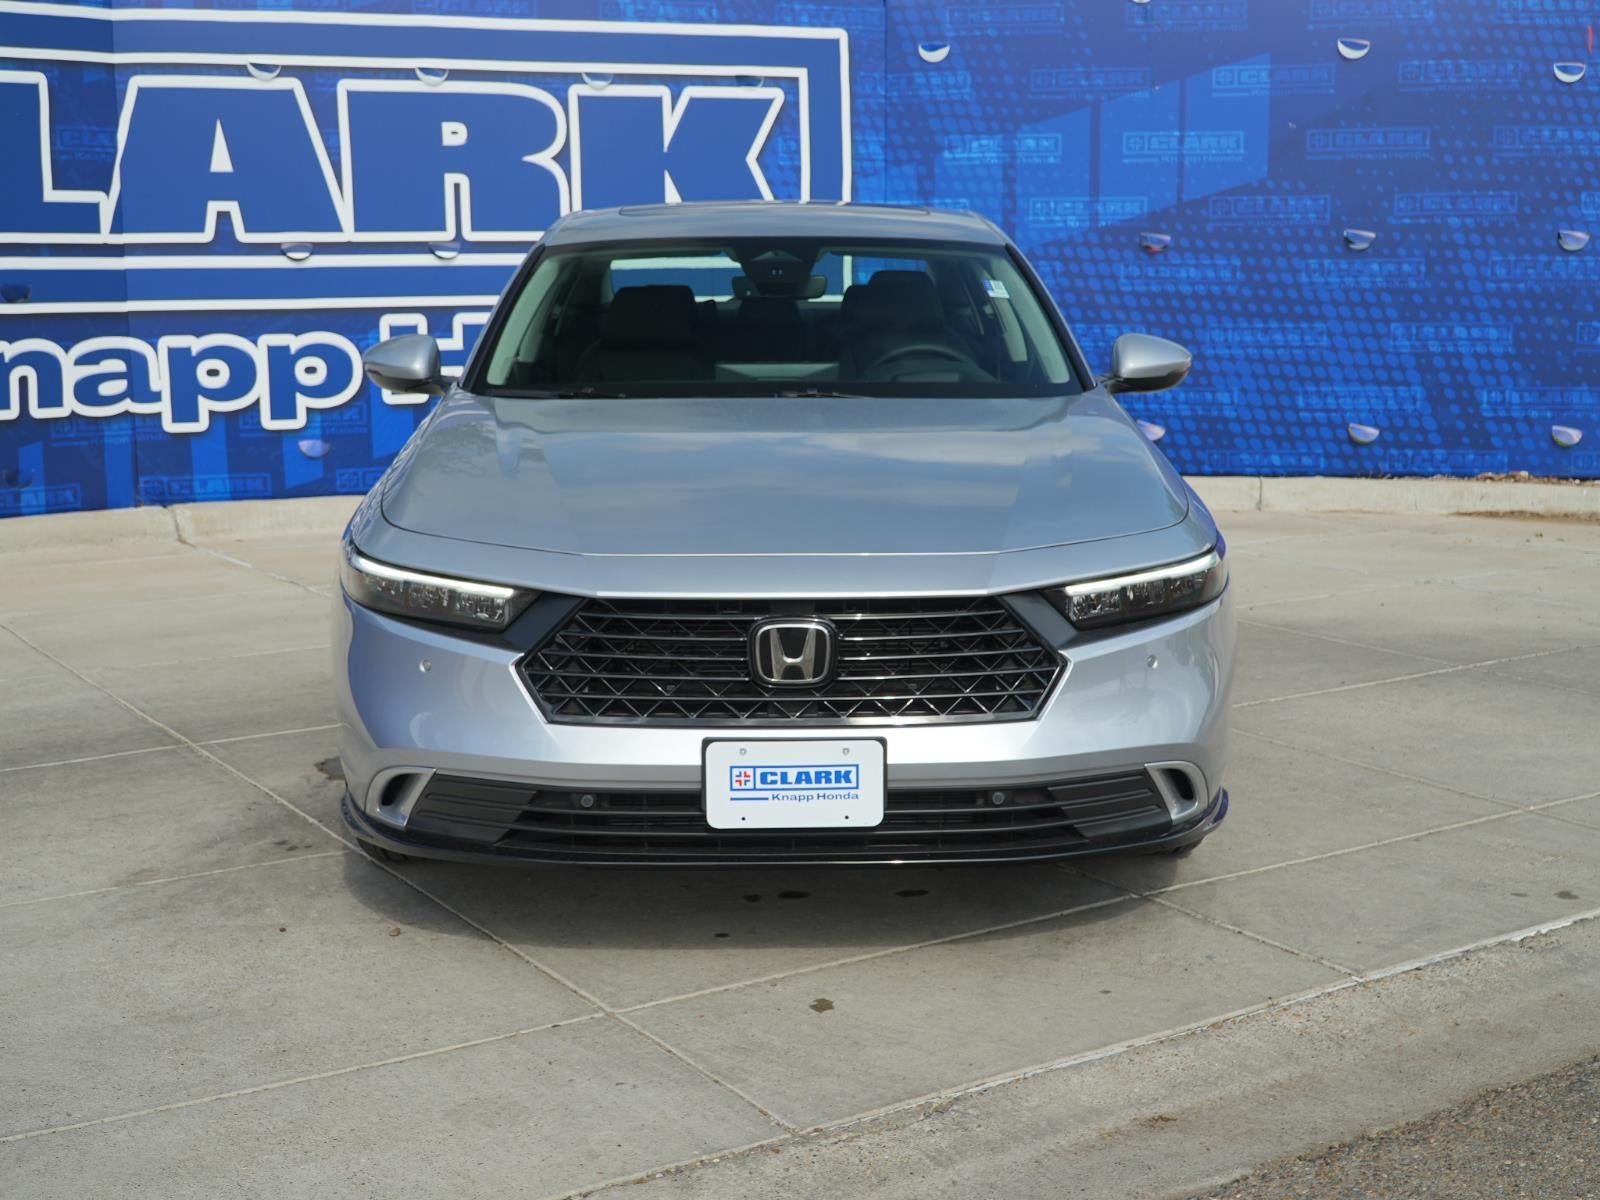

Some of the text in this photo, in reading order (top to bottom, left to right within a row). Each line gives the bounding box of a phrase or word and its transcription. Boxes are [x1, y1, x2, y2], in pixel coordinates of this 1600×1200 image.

[759, 770, 853, 785] CLARK
[771, 791, 859, 802] Knapp Honda
